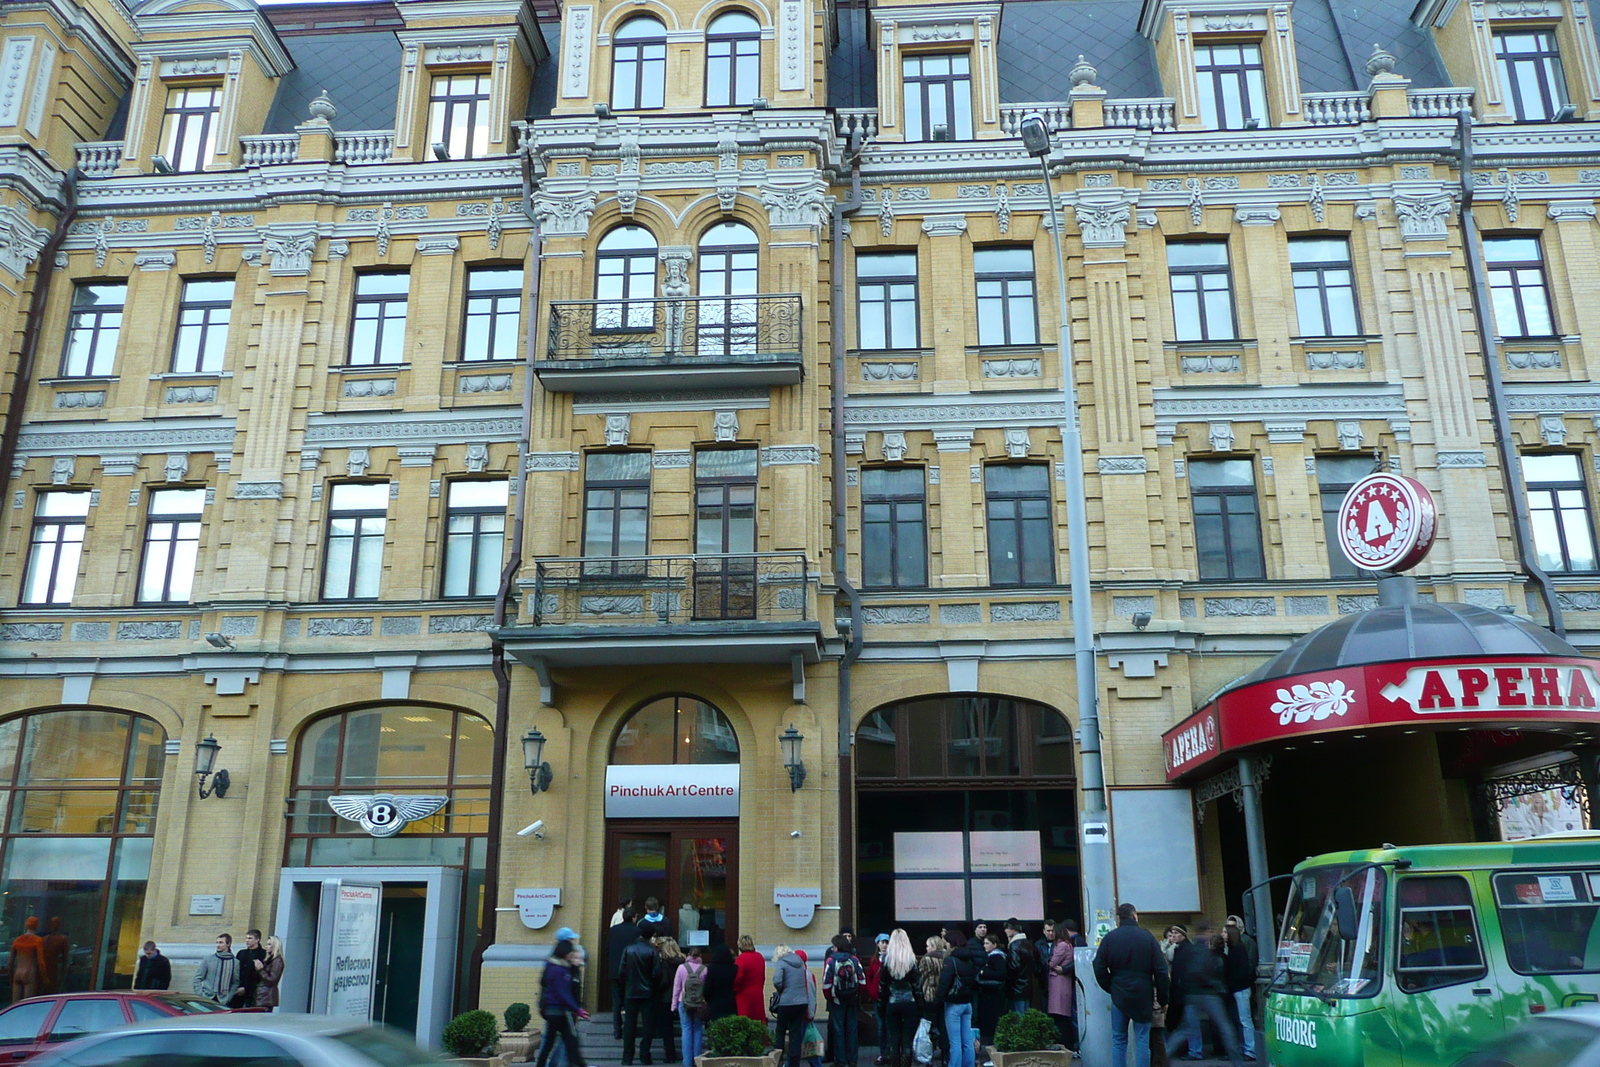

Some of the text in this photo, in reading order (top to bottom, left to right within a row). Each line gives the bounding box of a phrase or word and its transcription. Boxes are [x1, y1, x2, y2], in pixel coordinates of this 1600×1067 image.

[1364, 499, 1394, 542] А
[1417, 667, 1597, 709] АРЕНА
[1172, 721, 1207, 768] АРЕНА
[610, 784, 734, 797] PinchukArtCentre
[372, 804, 391, 824] B
[335, 955, 371, 971] Reflection
[1275, 1013, 1317, 1049] TUBORG
